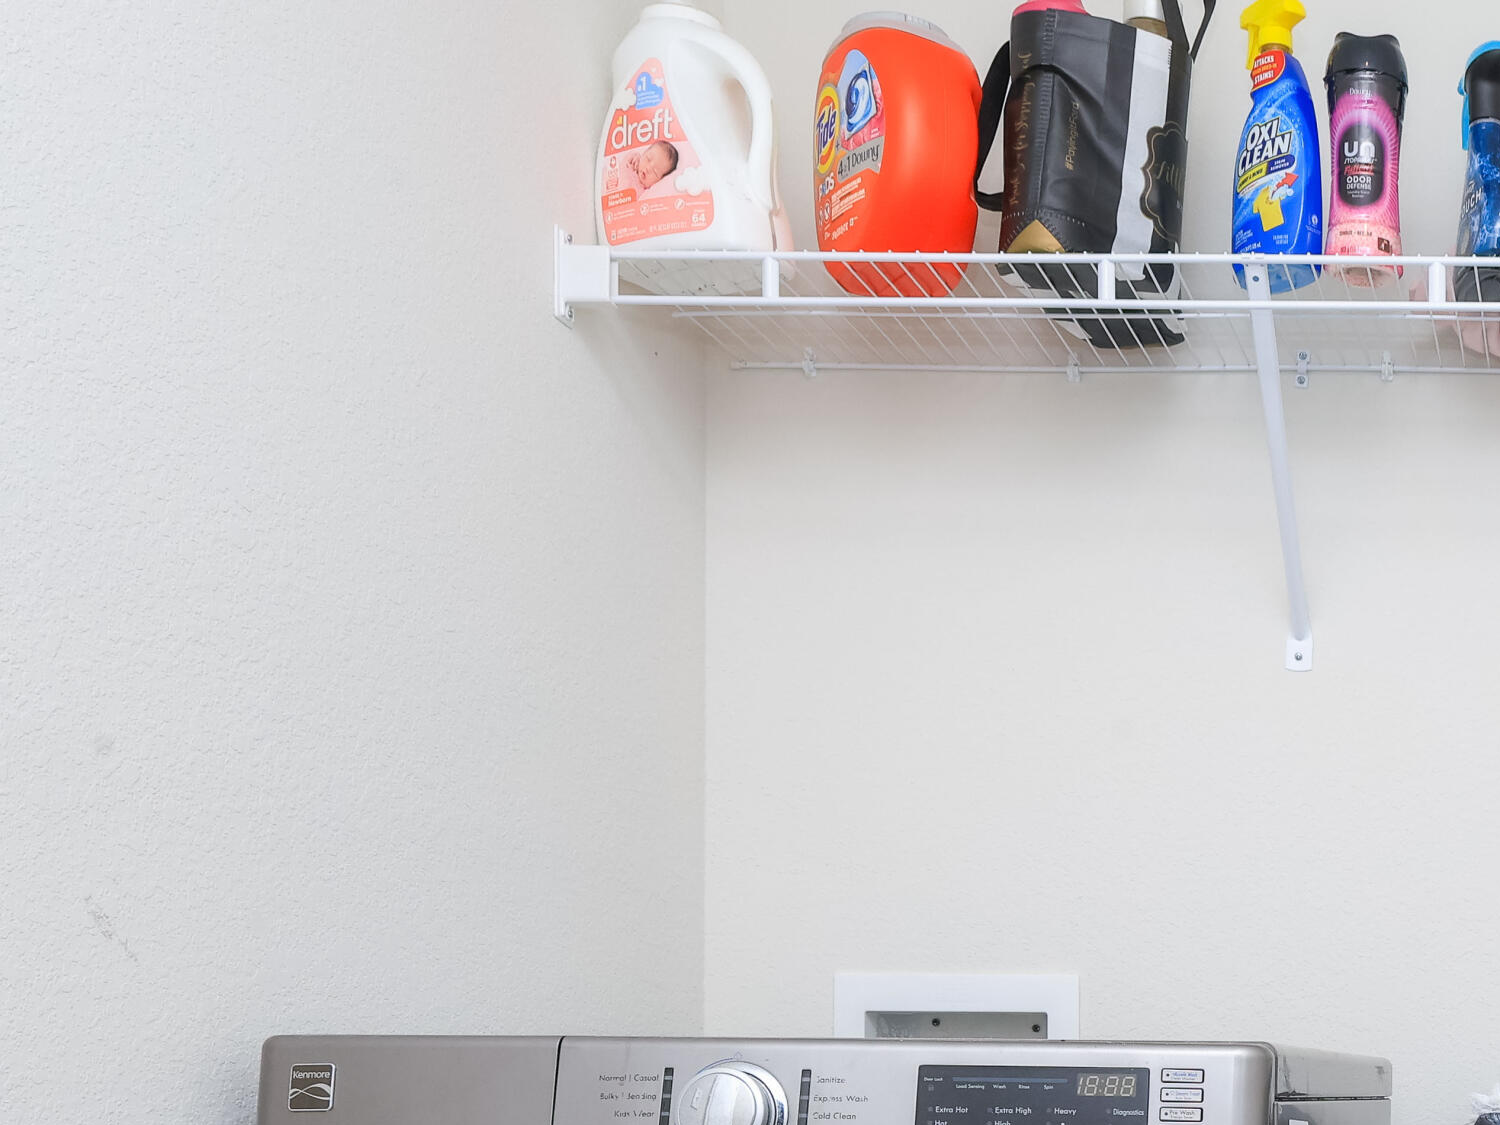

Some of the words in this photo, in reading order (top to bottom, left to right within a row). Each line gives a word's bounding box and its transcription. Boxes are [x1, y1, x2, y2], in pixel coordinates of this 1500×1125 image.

[611, 109, 673, 149] dreft
[816, 104, 837, 162] Tide
[1246, 117, 1280, 151] OXI
[1238, 132, 1292, 177] CLEAN
[1346, 175, 1372, 184] ODOR
[292, 1070, 331, 1080] Kenmore
[634, 1074, 659, 1082] Casual
[935, 1105, 954, 1113] Extra
[955, 1105, 969, 1113] Hot
[994, 1106, 1014, 1114] Extra
[1015, 1106, 1032, 1116] High
[1054, 1108, 1077, 1116] Heavy
[1112, 1108, 1145, 1116] Diagnostics
[813, 1112, 831, 1120] Cold
[833, 1112, 857, 1120] Clean
